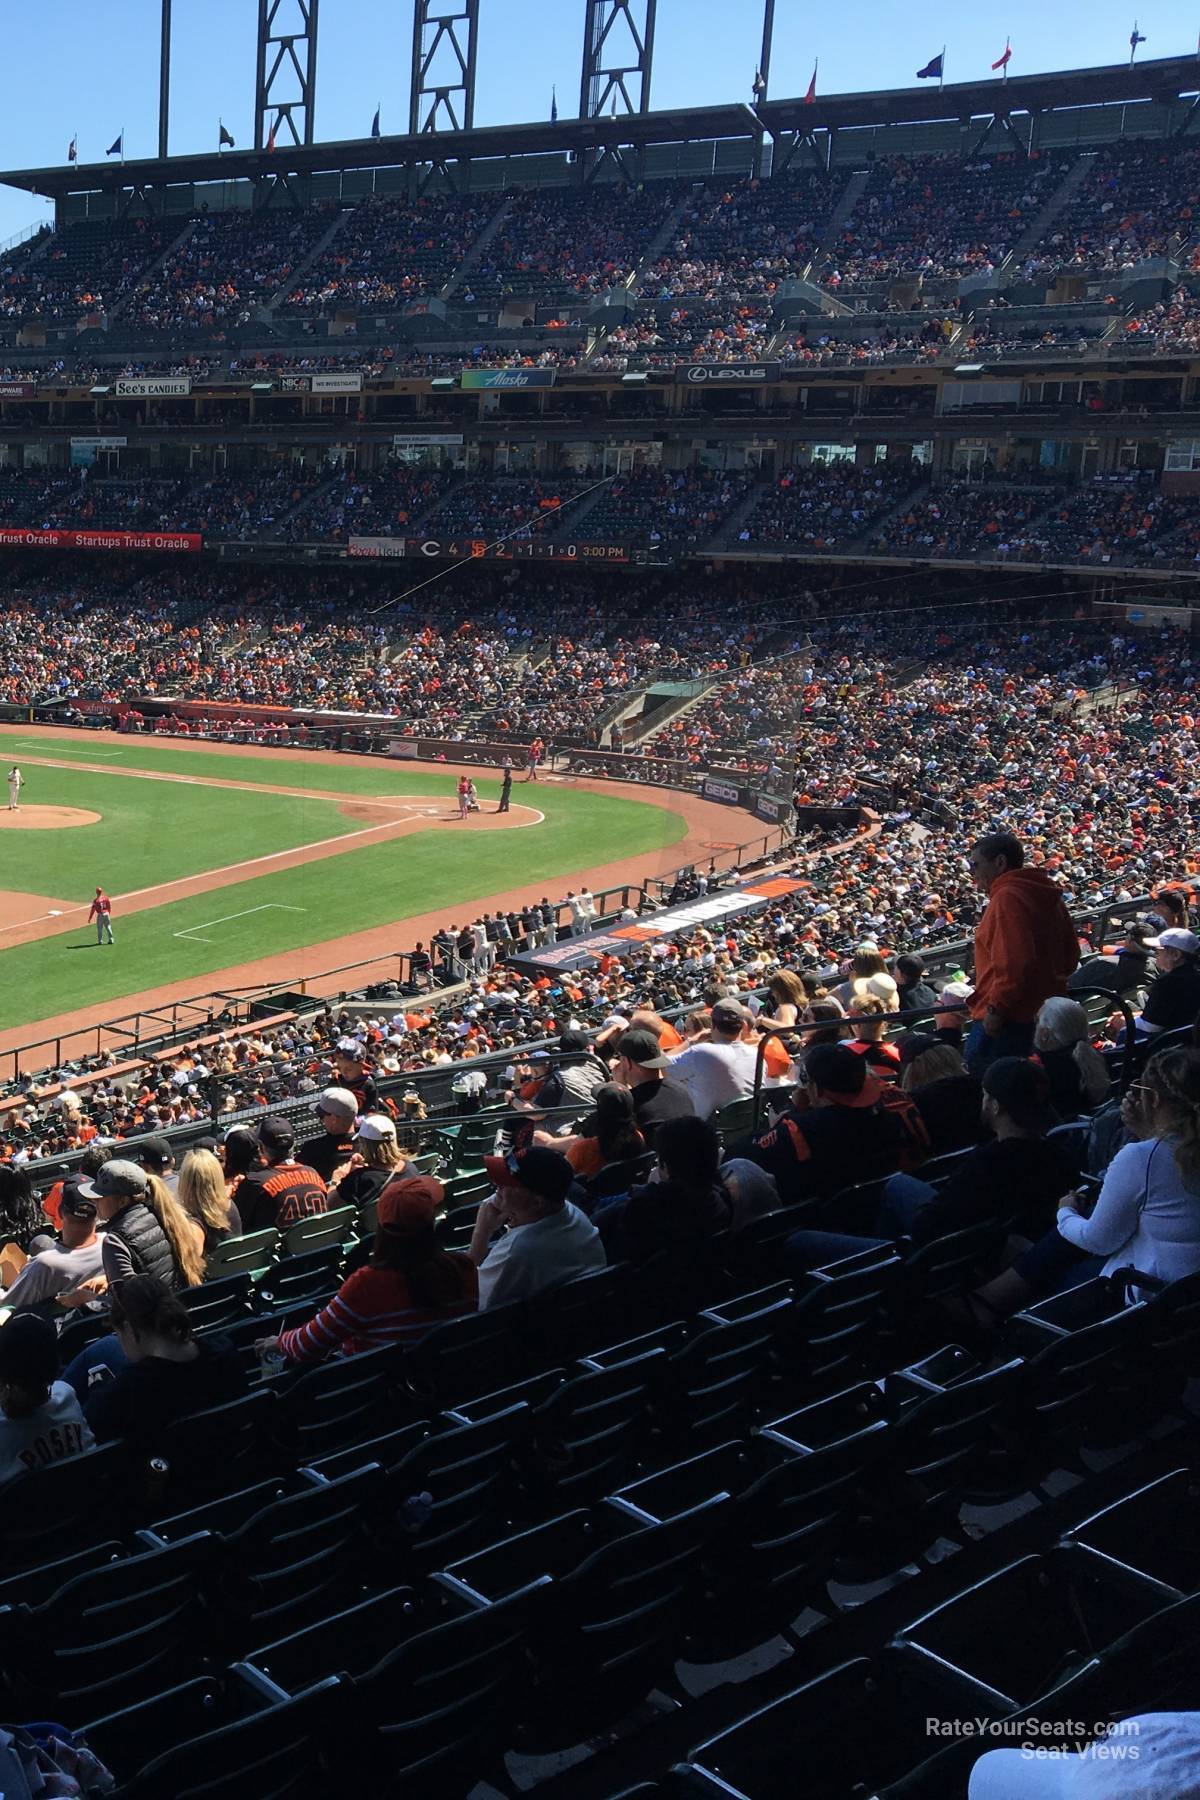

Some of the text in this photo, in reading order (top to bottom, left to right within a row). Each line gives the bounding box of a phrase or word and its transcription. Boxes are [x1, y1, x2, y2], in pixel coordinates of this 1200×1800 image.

[485, 373, 530, 387] Alaska
[706, 368, 766, 379] LEXUS
[117, 382, 186, 395] See's CANDIES
[26, 534, 58, 545] Oracle
[75, 535, 190, 549] Startups Trust Oracle
[448, 542, 459, 555] 4
[495, 543, 506, 556] 2
[527, 544, 534, 556] 1
[547, 544, 554, 556] 1
[567, 544, 577, 557] 0
[582, 546, 624, 557] 3:00 PM
[704, 783, 739, 801] GEICO
[757, 798, 779, 818] GEICO
